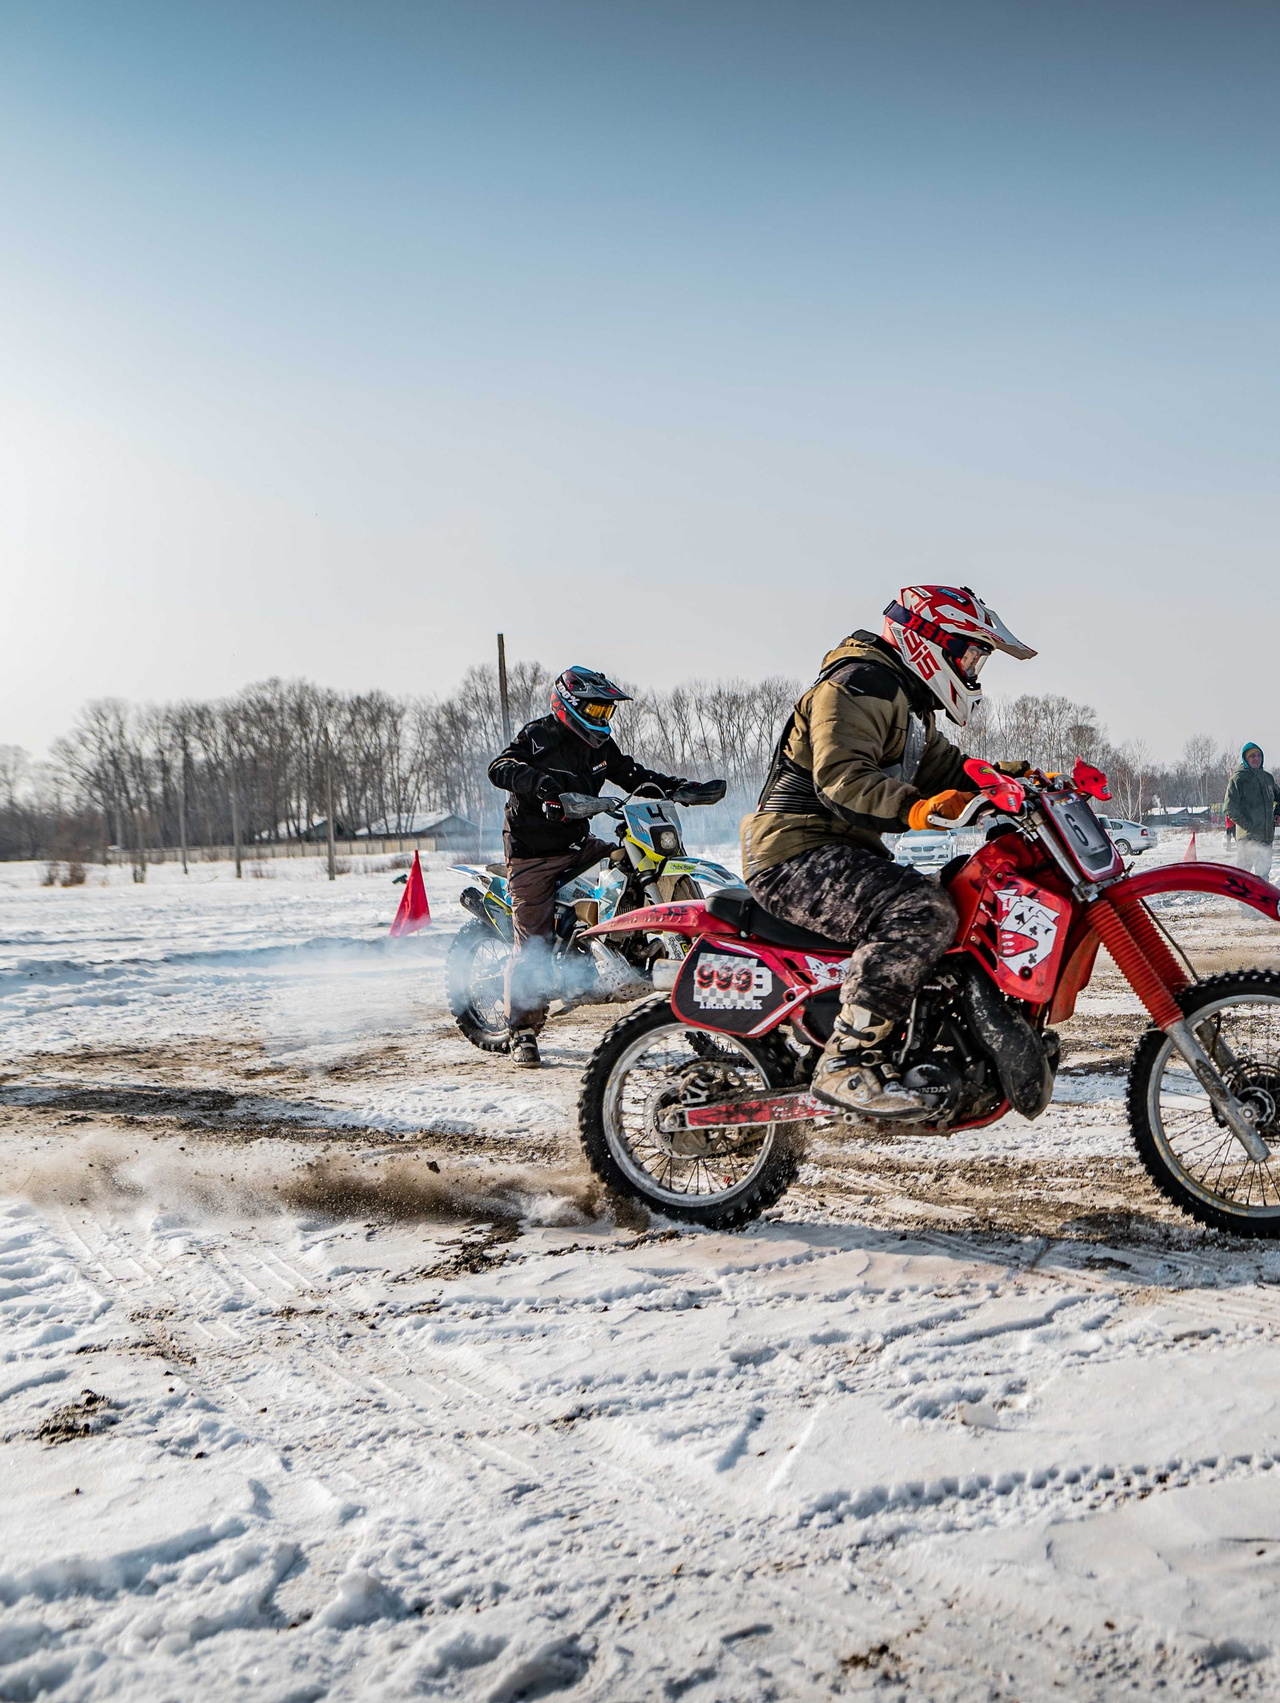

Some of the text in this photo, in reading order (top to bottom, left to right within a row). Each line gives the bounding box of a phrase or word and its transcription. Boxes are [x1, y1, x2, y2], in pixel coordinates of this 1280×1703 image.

[556, 682, 580, 706] 100%
[646, 804, 668, 823] 4
[1066, 814, 1088, 846] 6
[697, 963, 754, 993] 999
[911, 1085, 946, 1094] ONDA
